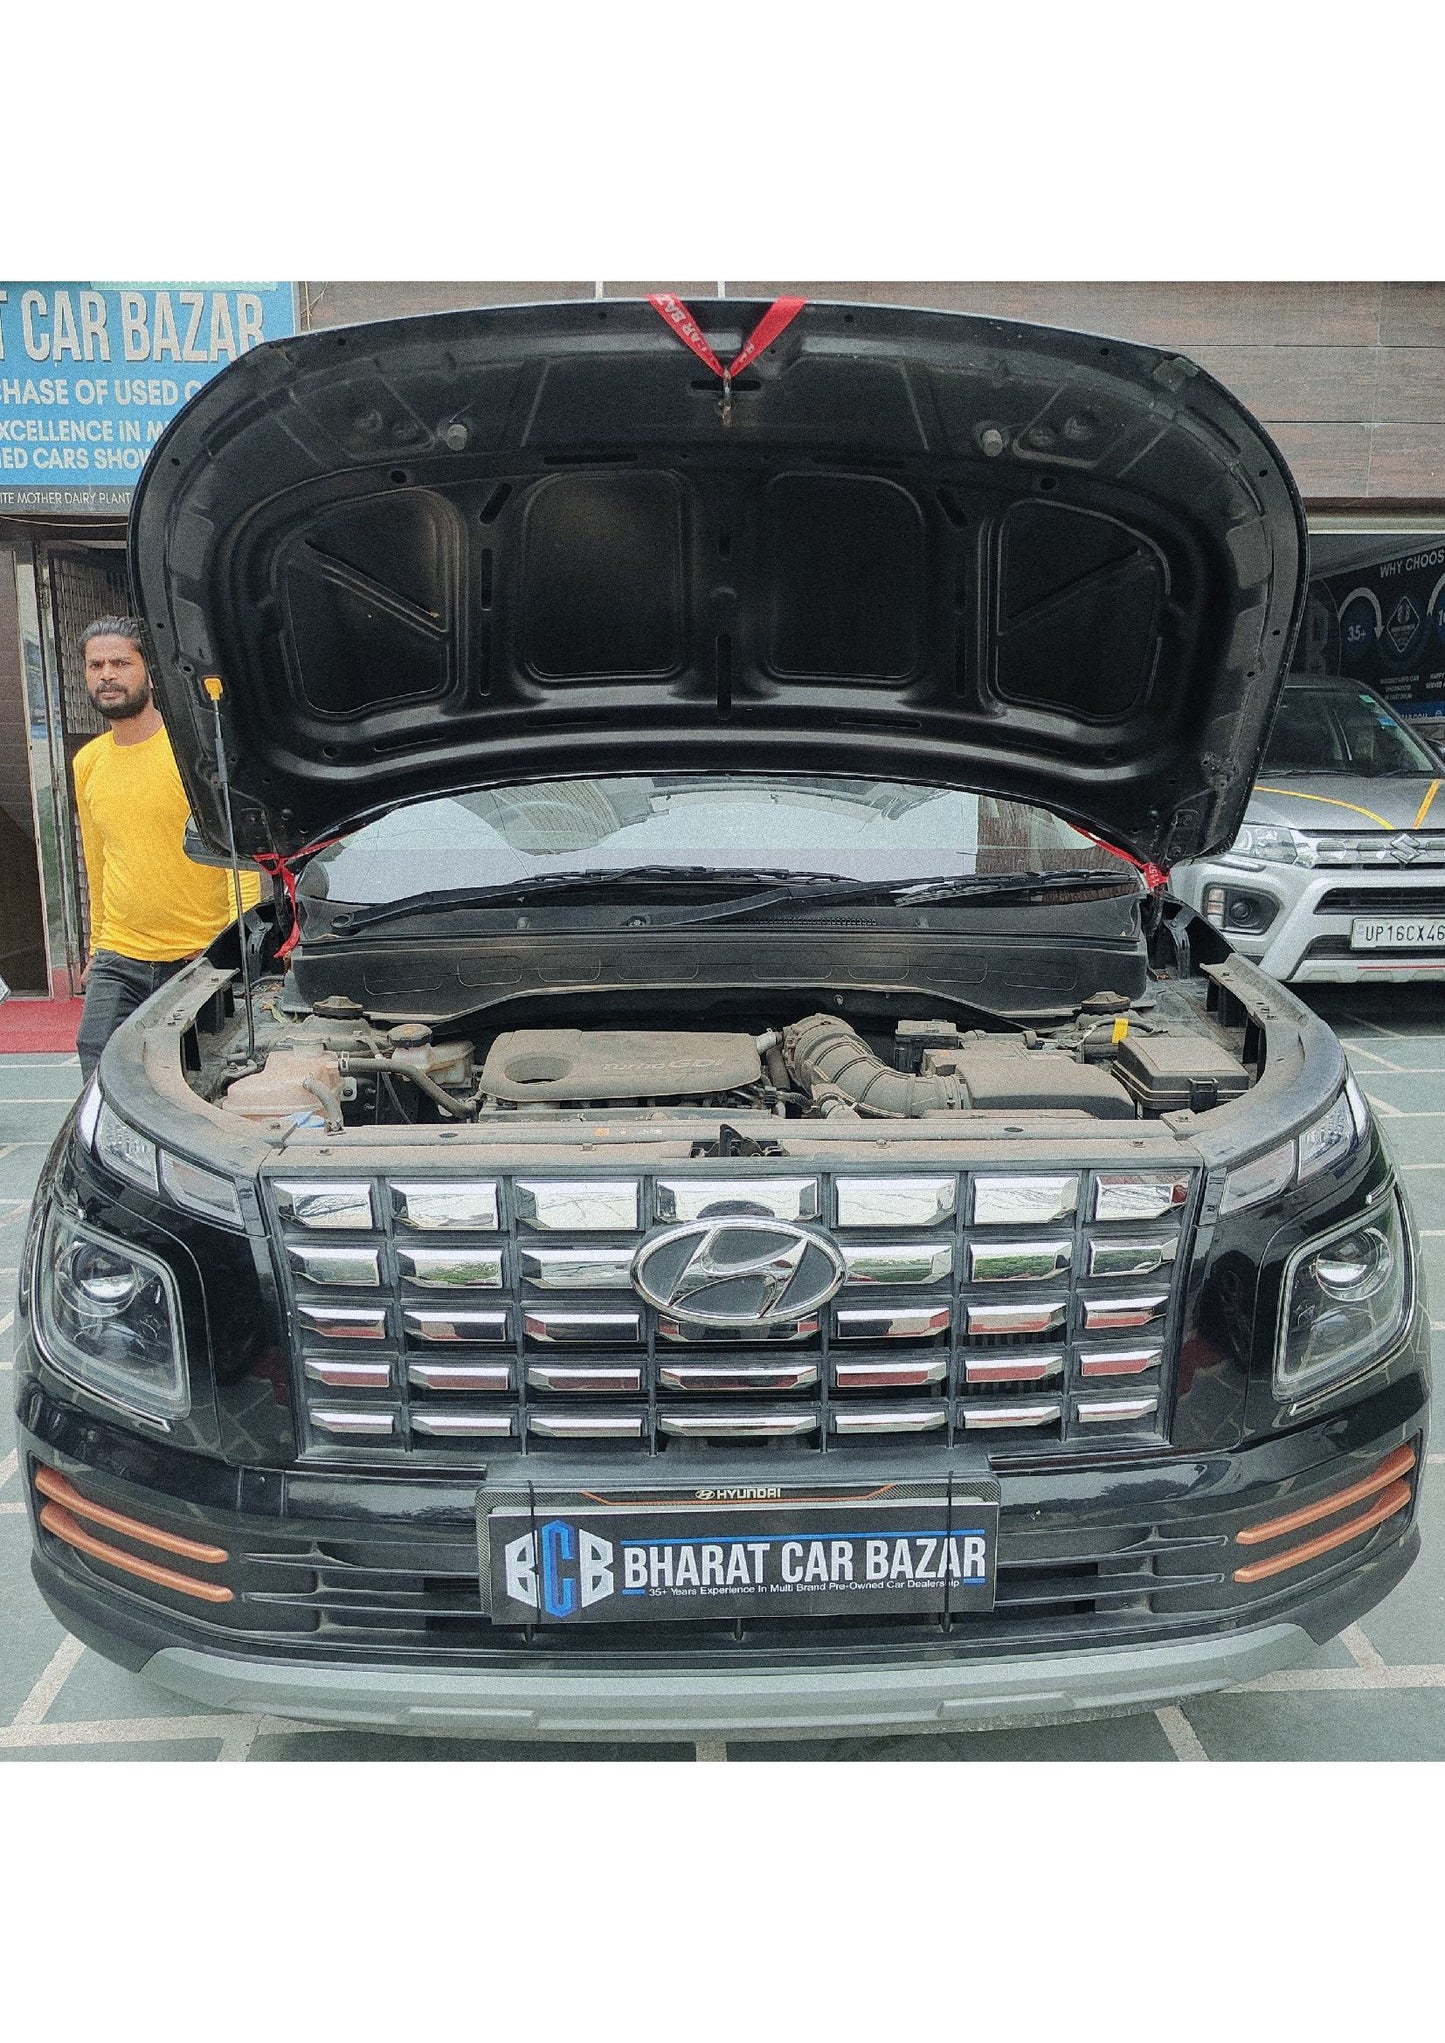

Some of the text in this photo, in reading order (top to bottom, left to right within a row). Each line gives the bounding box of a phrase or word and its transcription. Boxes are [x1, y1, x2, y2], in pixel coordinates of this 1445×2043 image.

[21, 290, 110, 362] CAR
[120, 290, 265, 362] BAZAR
[0, 378, 69, 405] HASE
[75, 379, 108, 405] OF
[114, 379, 178, 406] USED
[119, 420, 140, 442] IN
[147, 420, 169, 442] M
[0, 447, 28, 469] ED
[32, 447, 89, 469] CARS
[17, 492, 62, 504] MOTHER
[65, 492, 96, 504] DAIRY
[100, 492, 130, 504] PLANT
[1380, 561, 1403, 578] WHY
[716, 1487, 781, 1500] HYUNDAI
[504, 1519, 615, 1618] BCB
[623, 1536, 987, 1590] BHARAT CAR BAZAR
[648, 1578, 960, 1597] 35+ Years Experience In Multi Brand Pre-Owned Car Dealersip
